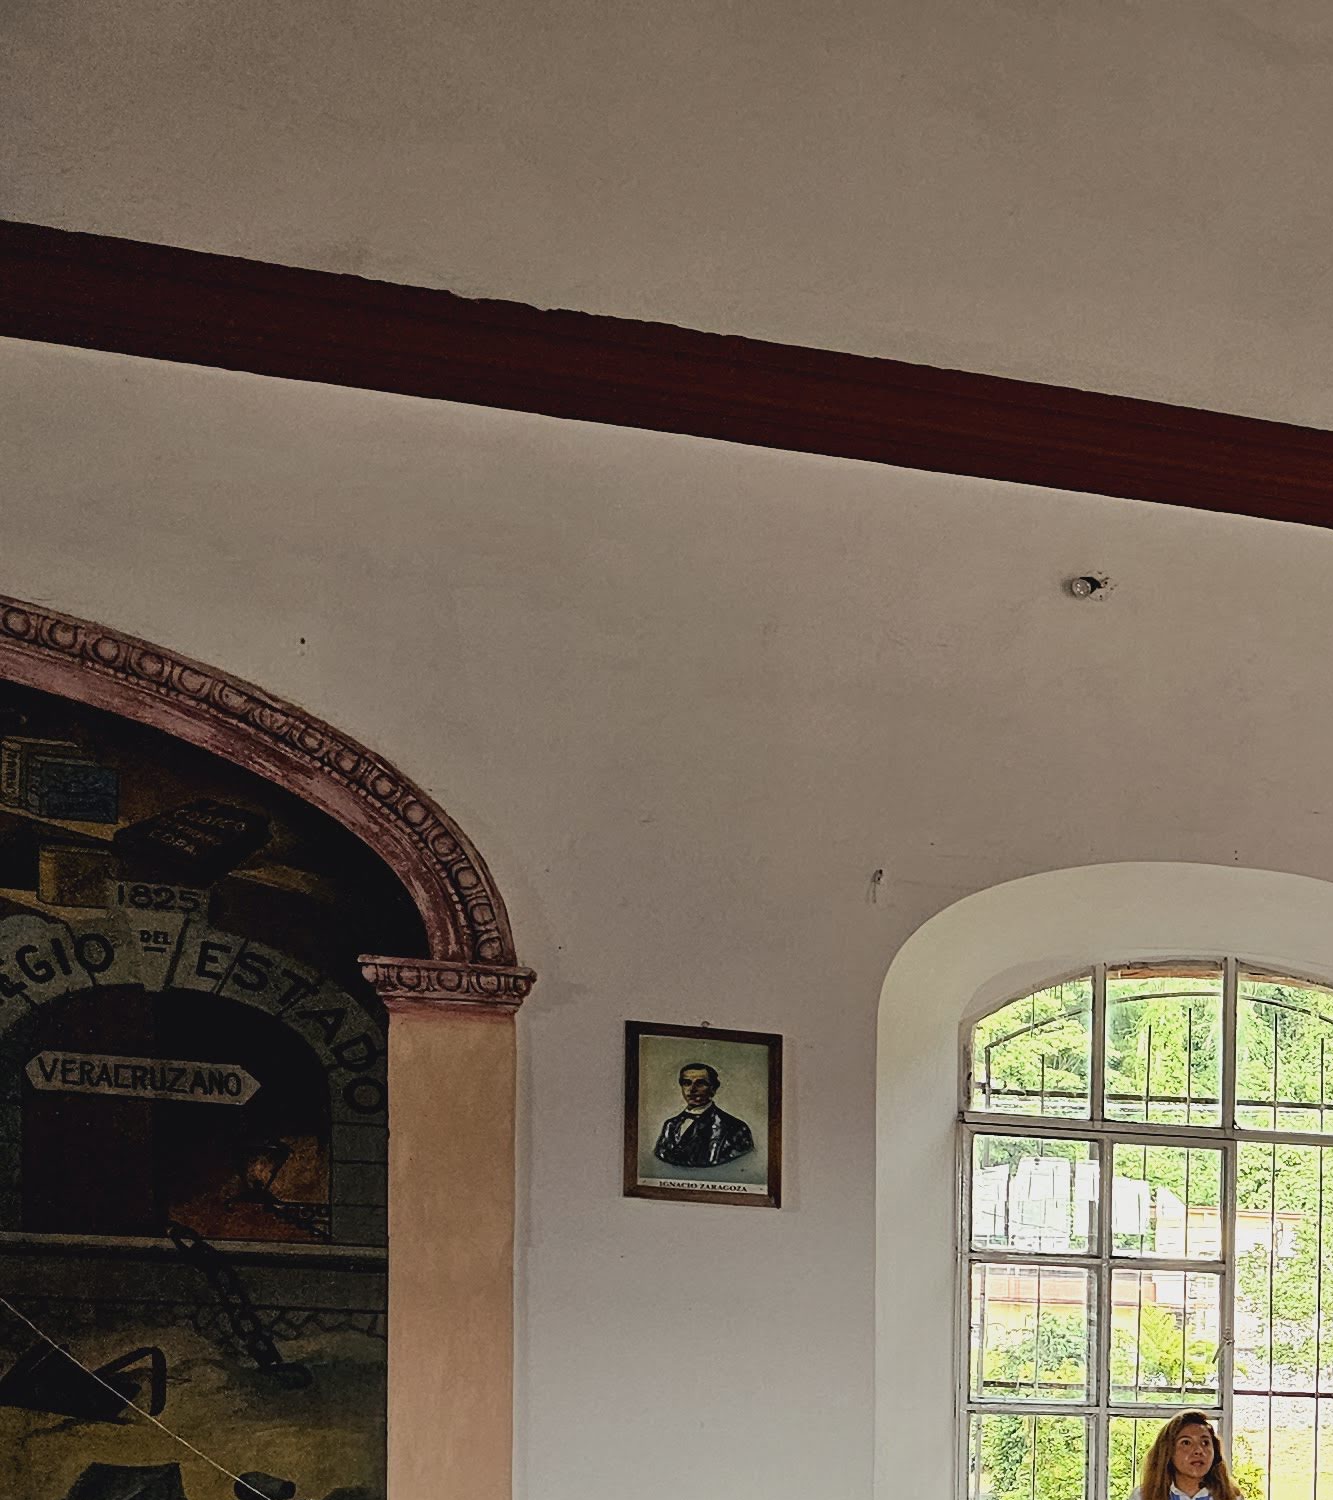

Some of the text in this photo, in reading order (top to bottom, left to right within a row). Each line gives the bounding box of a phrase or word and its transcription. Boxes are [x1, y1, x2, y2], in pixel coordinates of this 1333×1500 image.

[116, 880, 199, 912] 1825
[139, 929, 171, 946] DEL
[196, 940, 387, 1114] ESTADO
[37, 1058, 243, 1097] VERACRUZANO
[659, 1181, 748, 1192] IGNACIO ZARAGOZA
